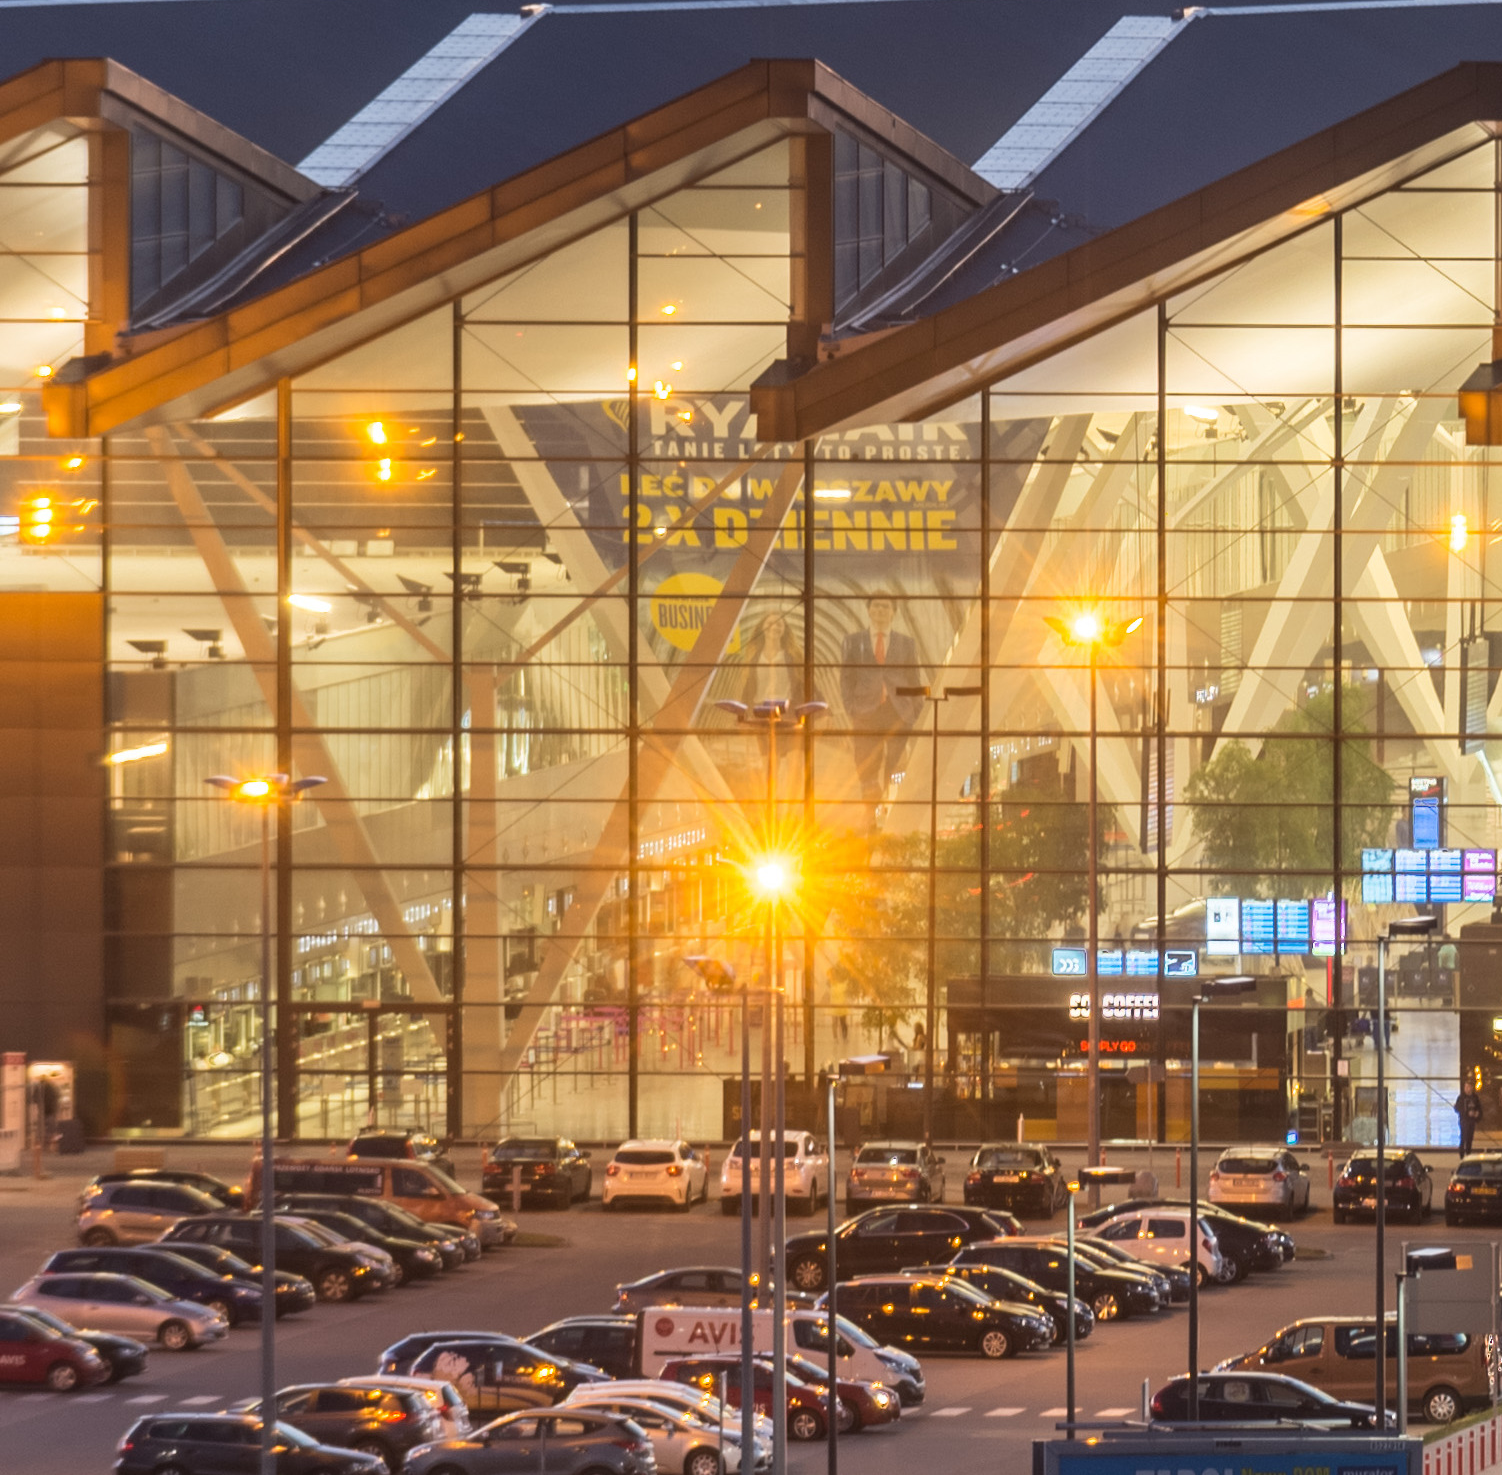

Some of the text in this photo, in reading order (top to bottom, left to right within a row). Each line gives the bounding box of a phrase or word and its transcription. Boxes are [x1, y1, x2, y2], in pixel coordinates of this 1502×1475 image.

[654, 439, 724, 459] TANIE
[739, 441, 796, 461] LTY
[821, 444, 849, 461] TO
[622, 503, 654, 544] 2
[688, 1321, 754, 1345] AVI
